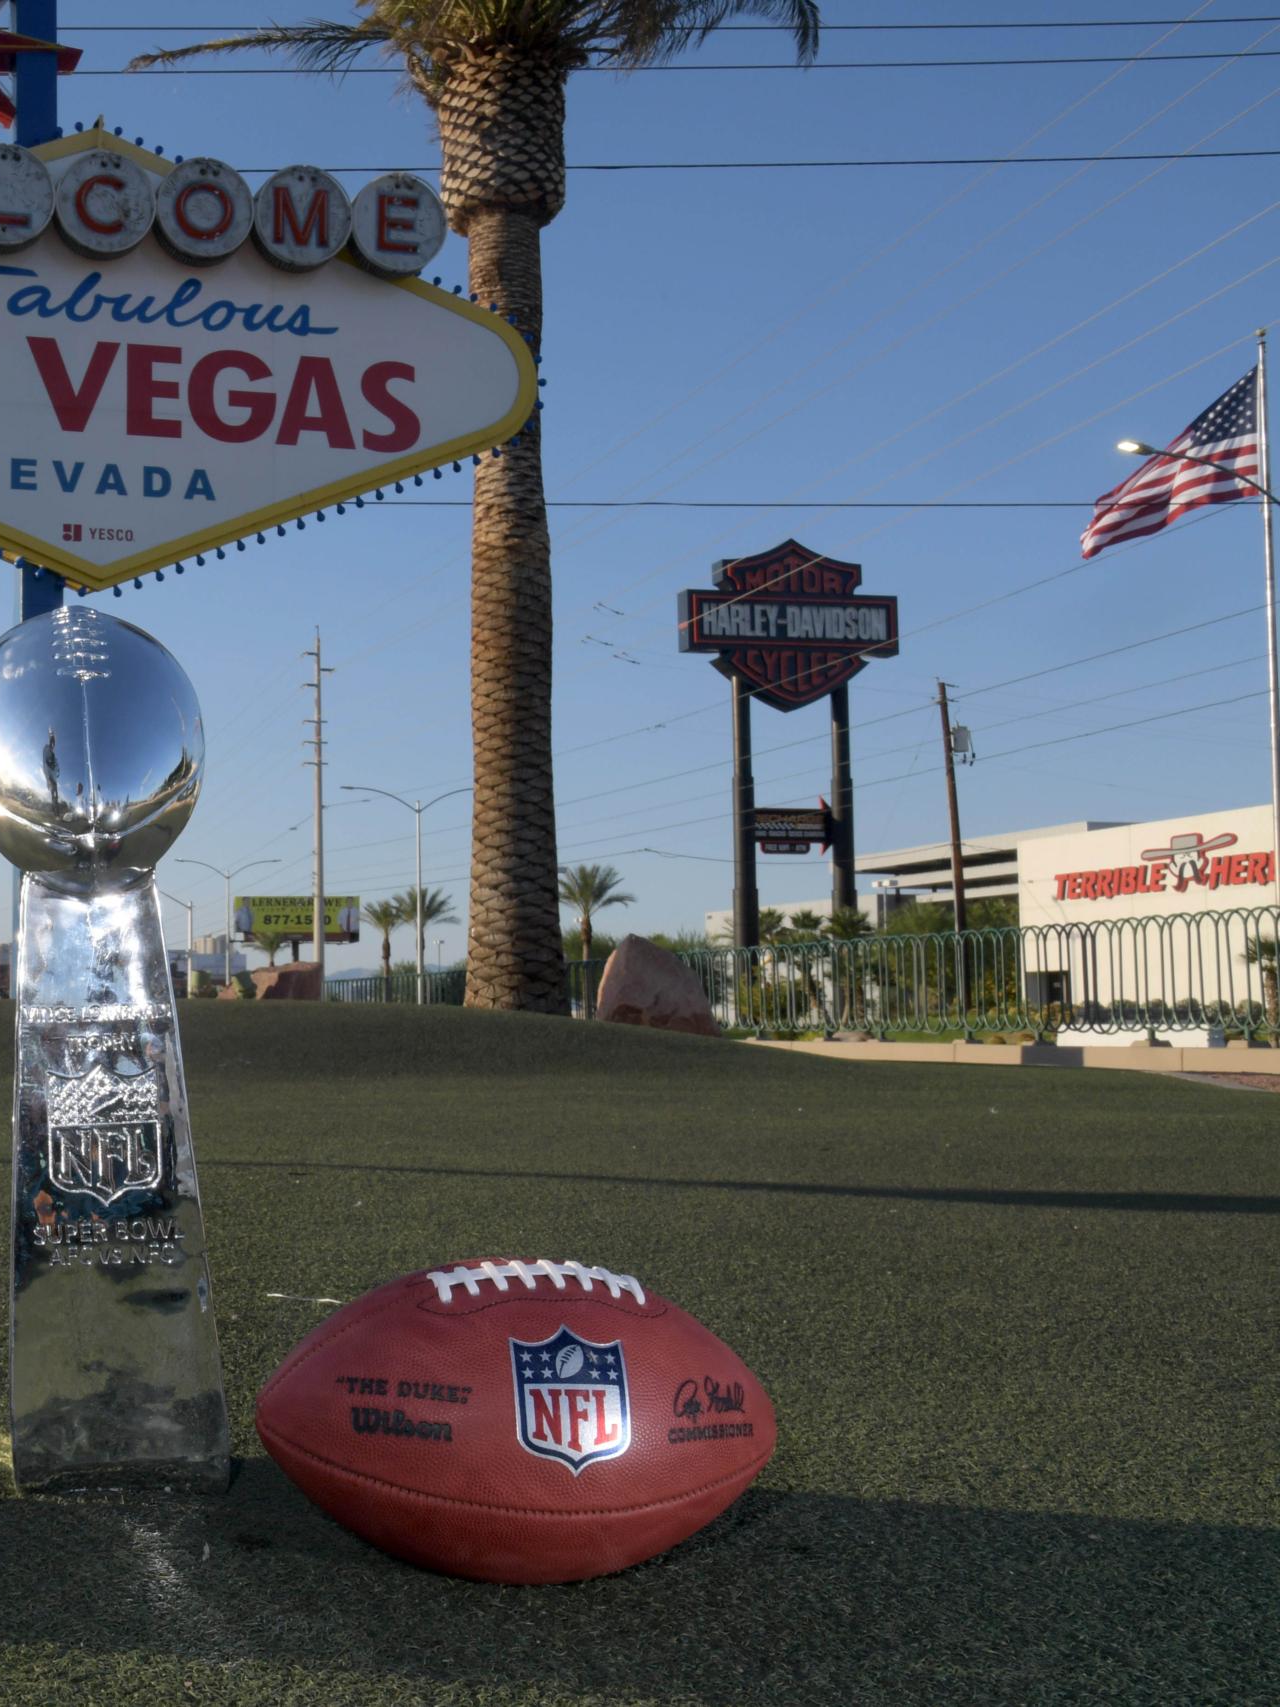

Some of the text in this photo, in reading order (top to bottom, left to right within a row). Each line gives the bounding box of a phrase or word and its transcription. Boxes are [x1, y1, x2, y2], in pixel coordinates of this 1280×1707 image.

[26, 335, 422, 453] VEGAS
[89, 527, 134, 542] YESCO
[745, 556, 843, 594] MOTOR
[702, 602, 888, 641] HARLEY-DAVIDSON
[746, 650, 841, 692] CYCLES
[1054, 863, 1168, 900] TERRIBLE
[263, 915, 332, 925] 877-150
[21, 1006, 77, 1023] VINCE
[66, 1033, 136, 1052] TROPHY
[56, 1128, 157, 1194] NFL
[33, 1217, 185, 1246] SUPER BOWL
[49, 1246, 93, 1266] AFC
[130, 1241, 175, 1264] NFC
[351, 1407, 453, 1442] Wilson
[528, 1388, 618, 1453] NFL
